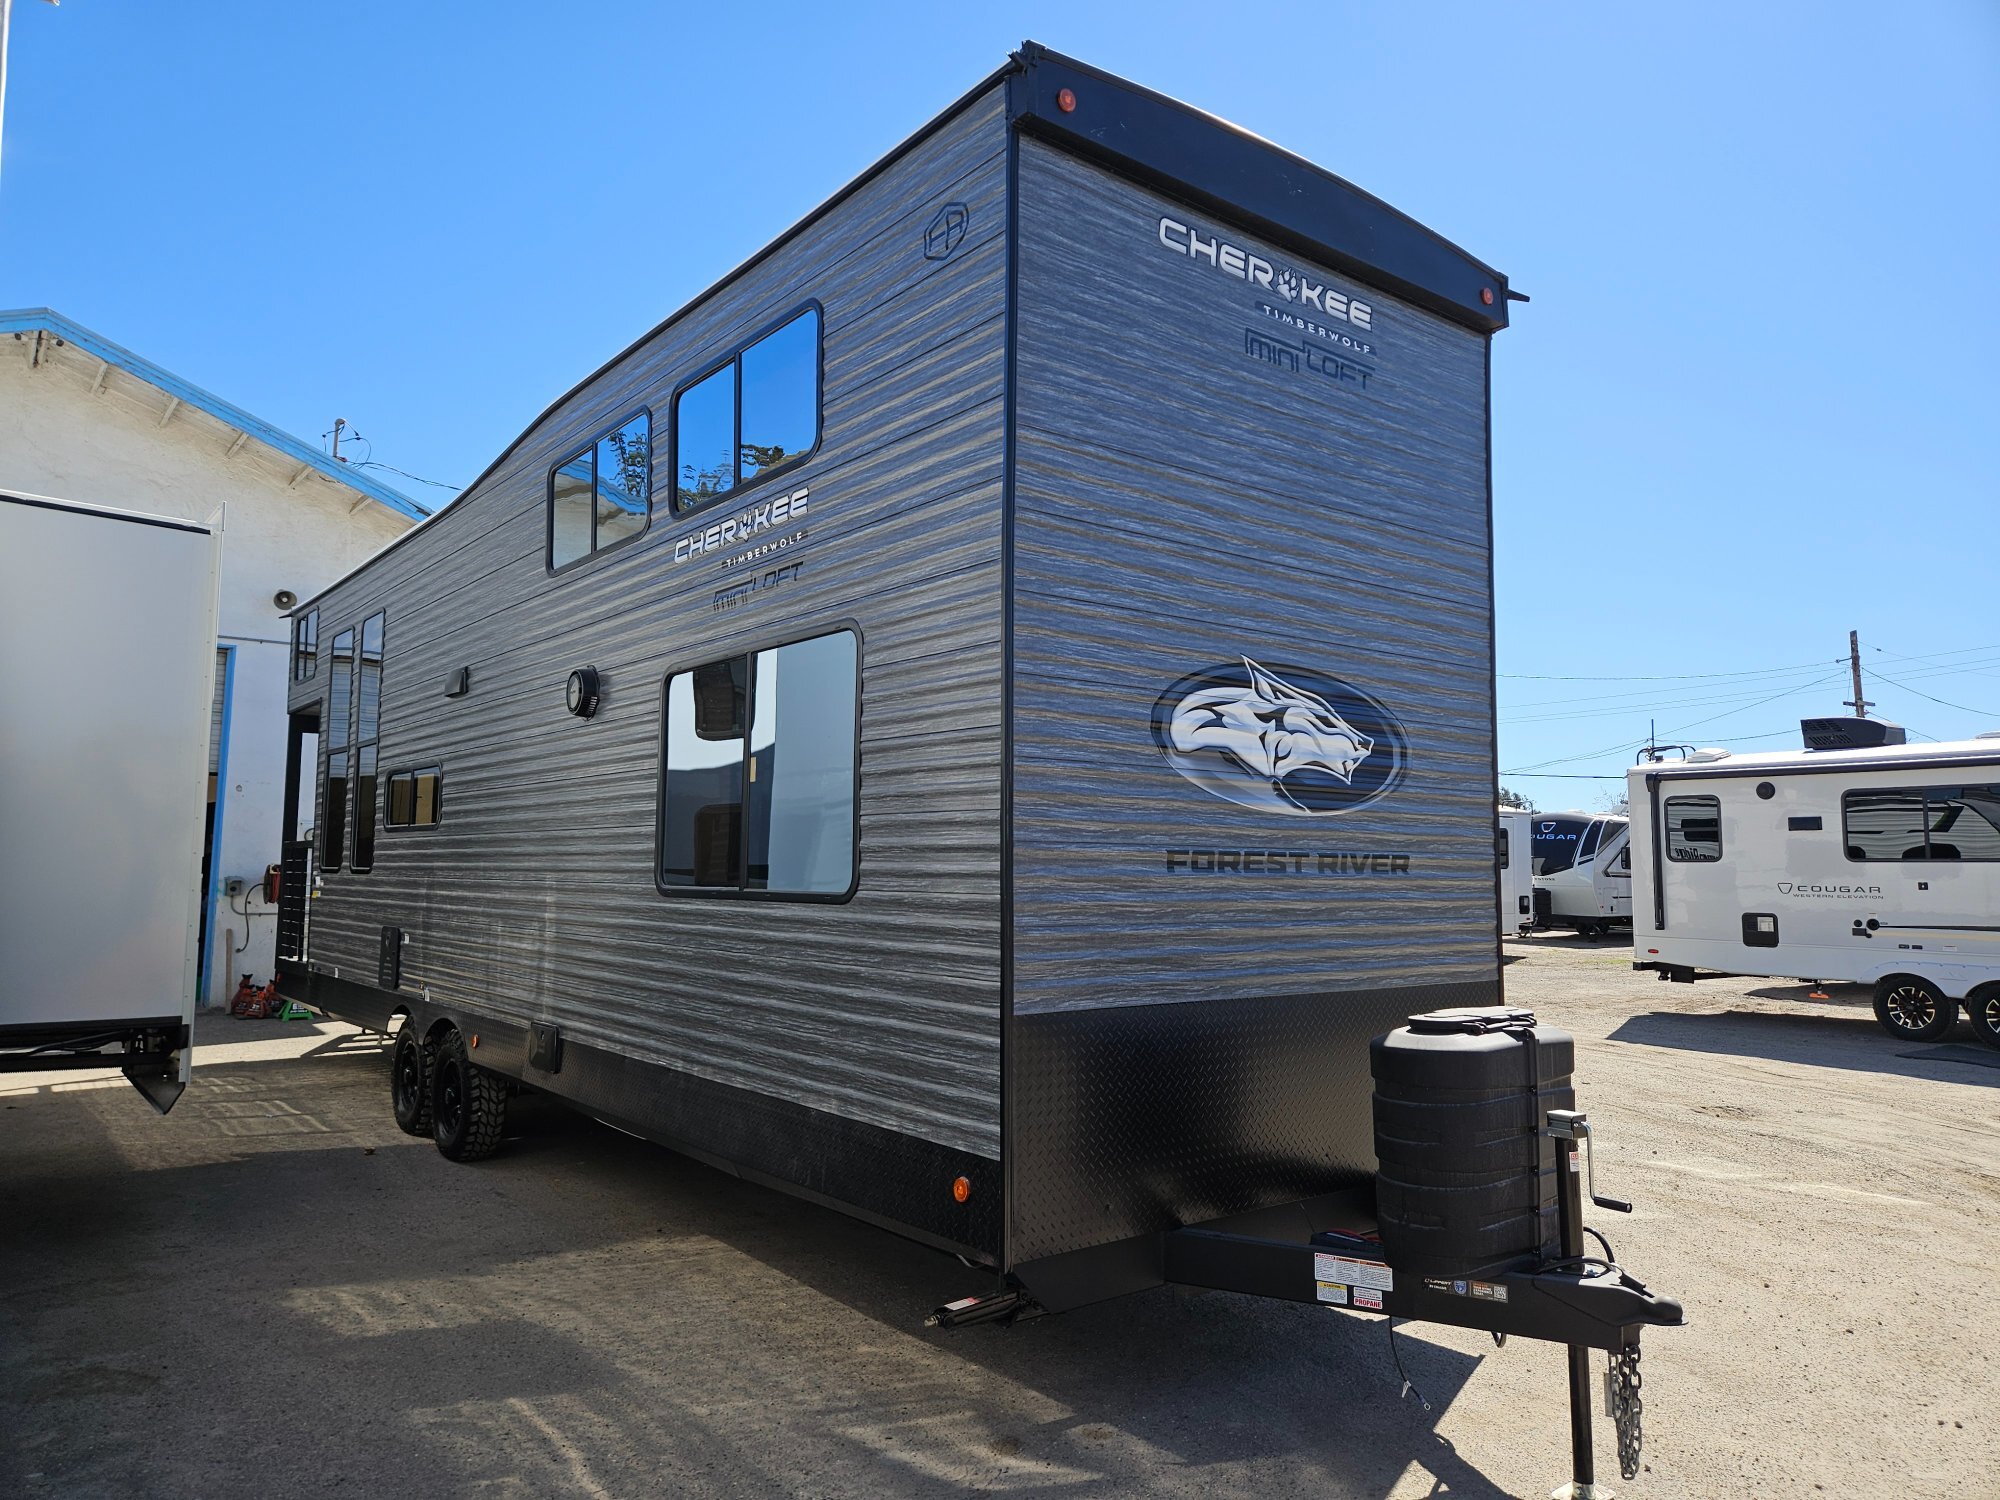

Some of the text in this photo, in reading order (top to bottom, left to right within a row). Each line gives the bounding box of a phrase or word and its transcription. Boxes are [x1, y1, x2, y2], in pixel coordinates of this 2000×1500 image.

[1263, 304, 1371, 355] TIMBERWOLF
[726, 531, 803, 568] TIMBERWOLF
[1165, 849, 1411, 876] FOREST RIVER
[1797, 885, 1881, 894] COUGAR
[1355, 1298, 1382, 1308] PROPANE
